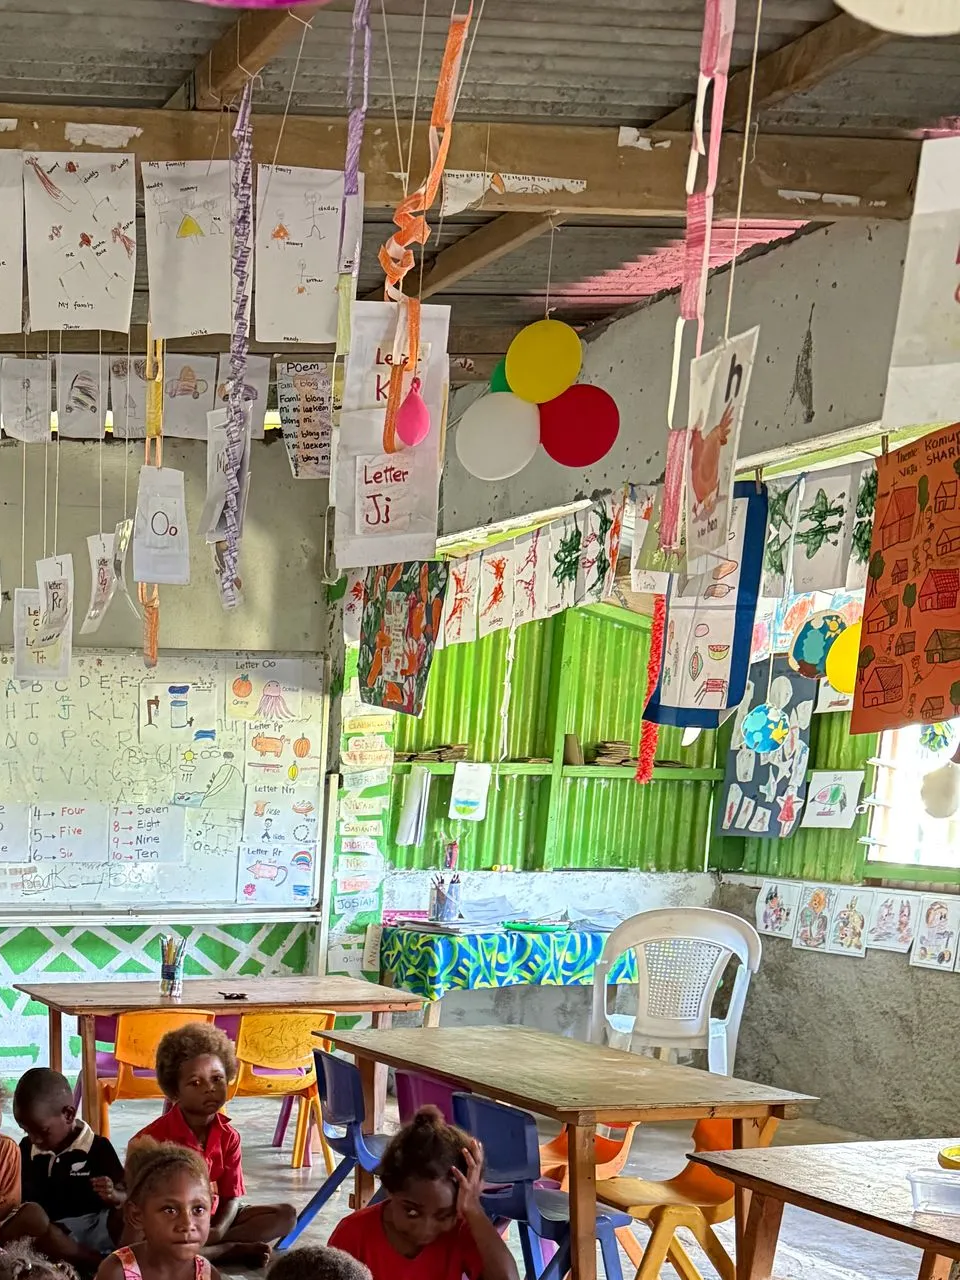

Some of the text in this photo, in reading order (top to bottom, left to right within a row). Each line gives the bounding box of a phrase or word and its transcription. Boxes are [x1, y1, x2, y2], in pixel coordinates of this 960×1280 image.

[725, 353, 742, 403] h
[364, 465, 409, 485] Letter
[235, 661, 259, 670] Letter
[249, 722, 271, 730] Letter
[254, 785, 278, 794] Letter
[33, 807, 85, 821] 4 Four
[112, 805, 169, 816] 7 Seven
[113, 820, 160, 832] 8 Eight
[32, 826, 82, 842] 5 Five
[112, 835, 160, 848] 9 Nine
[33, 849, 42, 861] 6
[112, 849, 159, 860] 10 Ten
[247, 848, 268, 856] Letter
